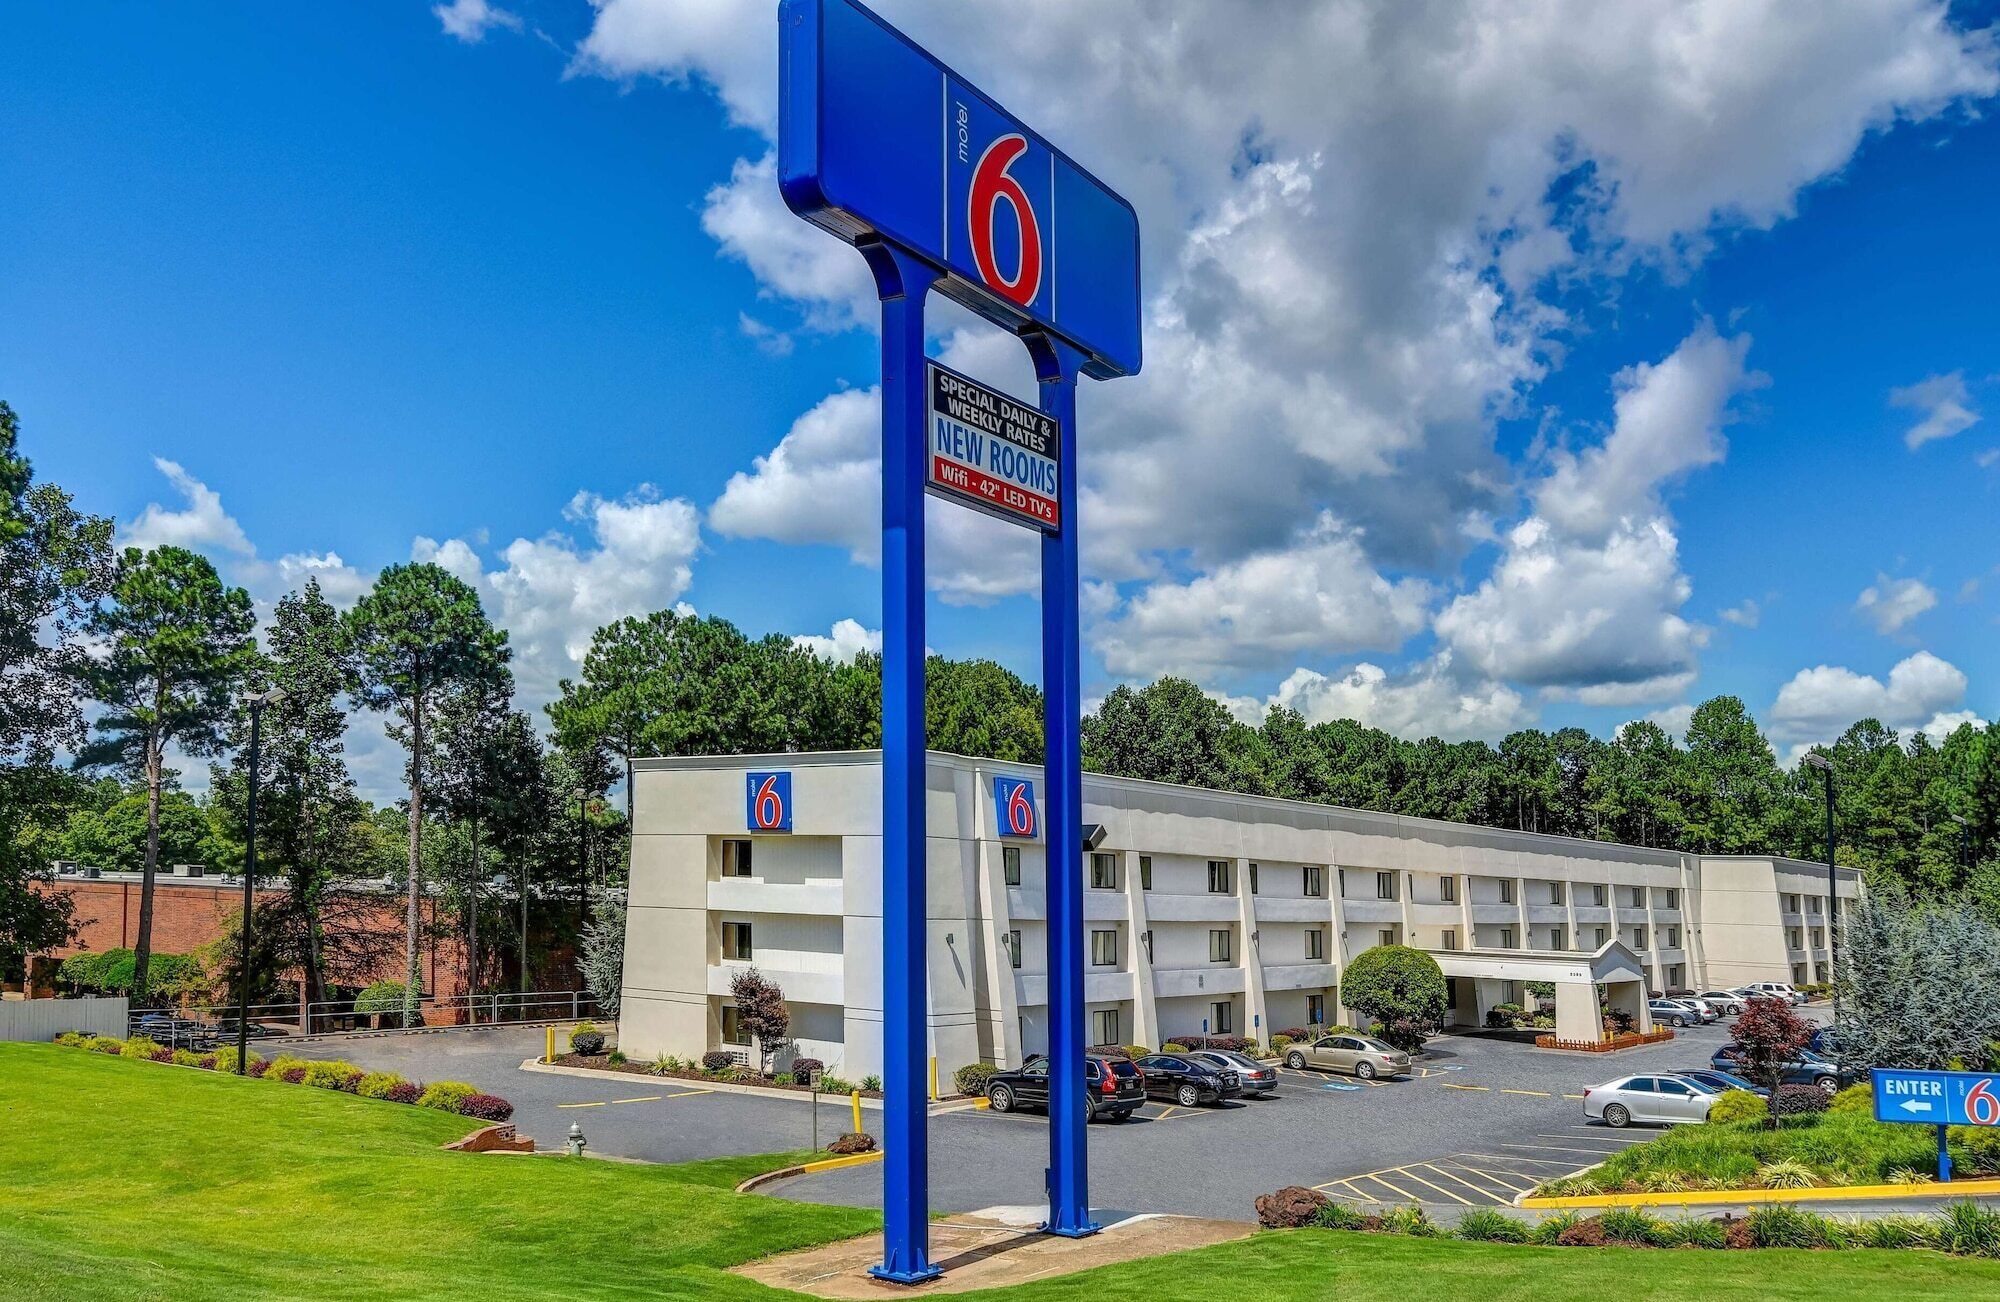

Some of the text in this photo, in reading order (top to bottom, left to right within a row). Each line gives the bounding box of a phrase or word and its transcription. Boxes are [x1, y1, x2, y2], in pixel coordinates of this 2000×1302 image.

[956, 100, 968, 163] motel
[968, 133, 1042, 307] 6
[940, 375, 1051, 438] SPECIAL DAILY &
[947, 397, 1046, 453] WEEKLY RATES
[937, 418, 1056, 495] NEW ROOMS
[941, 463, 968, 487] Wifi
[980, 480, 1000, 498] 42"
[1003, 487, 1026, 508] LED
[1029, 497, 1052, 518] TV's
[755, 775, 783, 828] 6
[1008, 783, 1033, 834] 6
[1885, 1079, 1943, 1096] ENTER
[1964, 1078, 2000, 1125] 6
